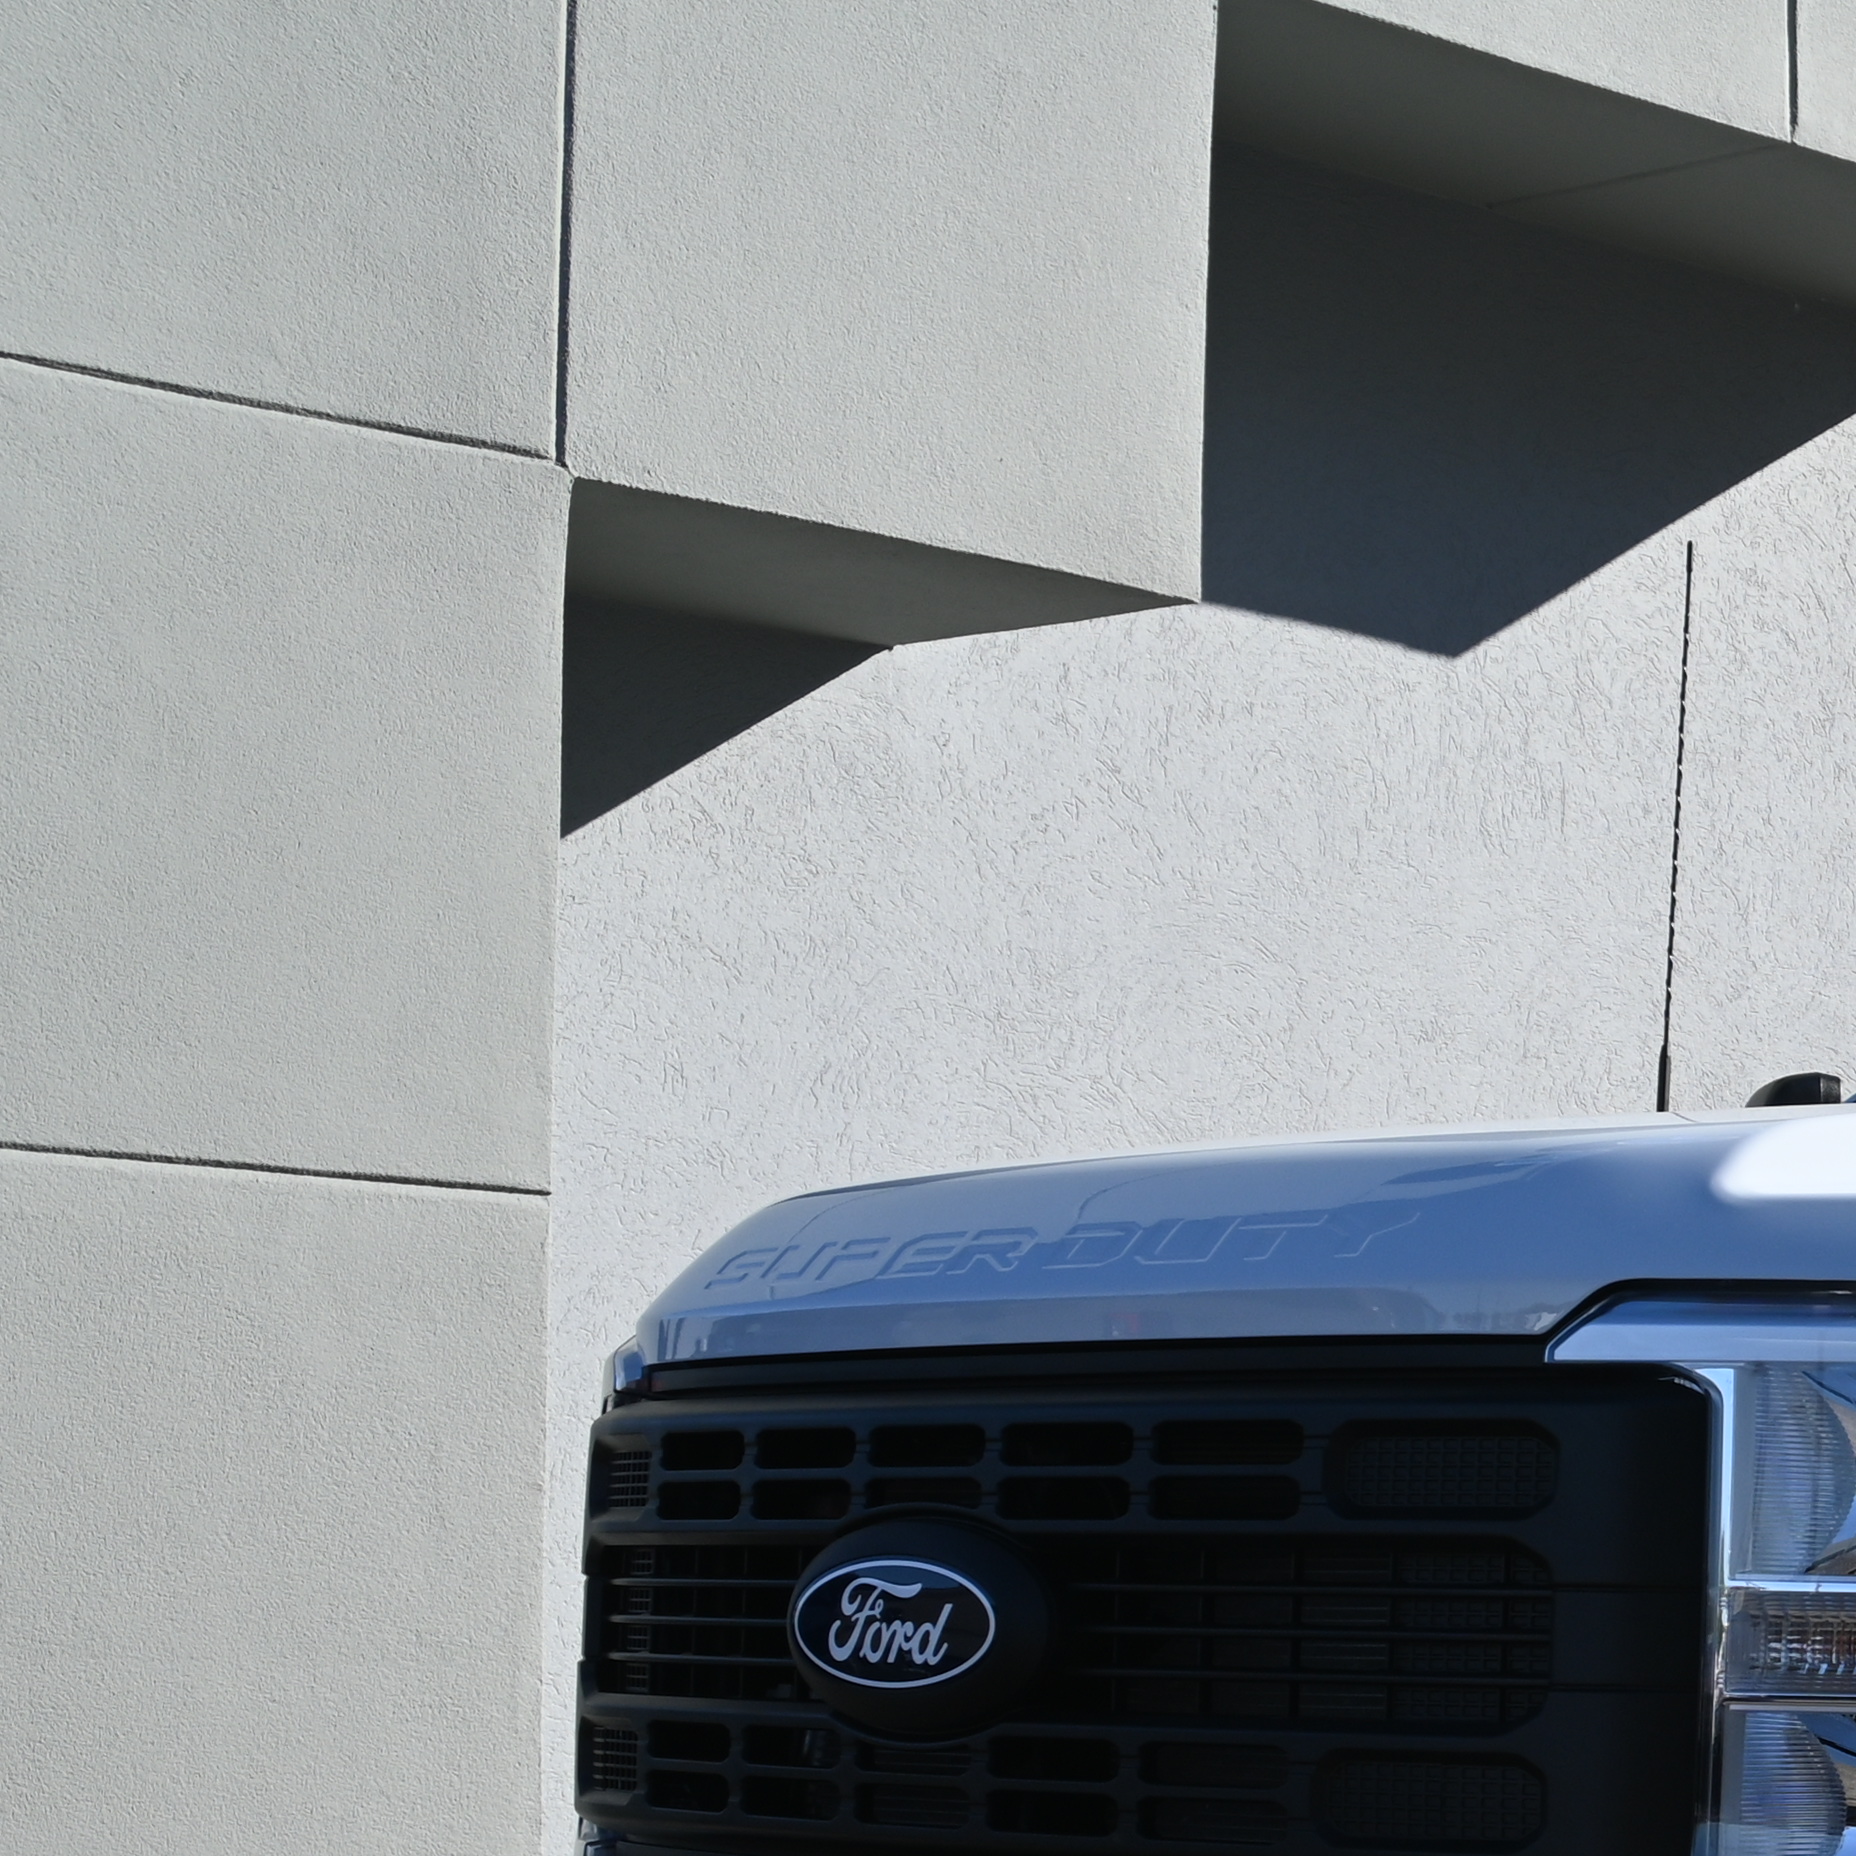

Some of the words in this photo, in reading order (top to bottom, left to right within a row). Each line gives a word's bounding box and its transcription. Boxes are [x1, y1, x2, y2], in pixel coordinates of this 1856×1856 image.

[704, 1227, 1039, 1290] SUPER
[1045, 1212, 1421, 1270] DUTY
[828, 1576, 953, 1668] Ford
